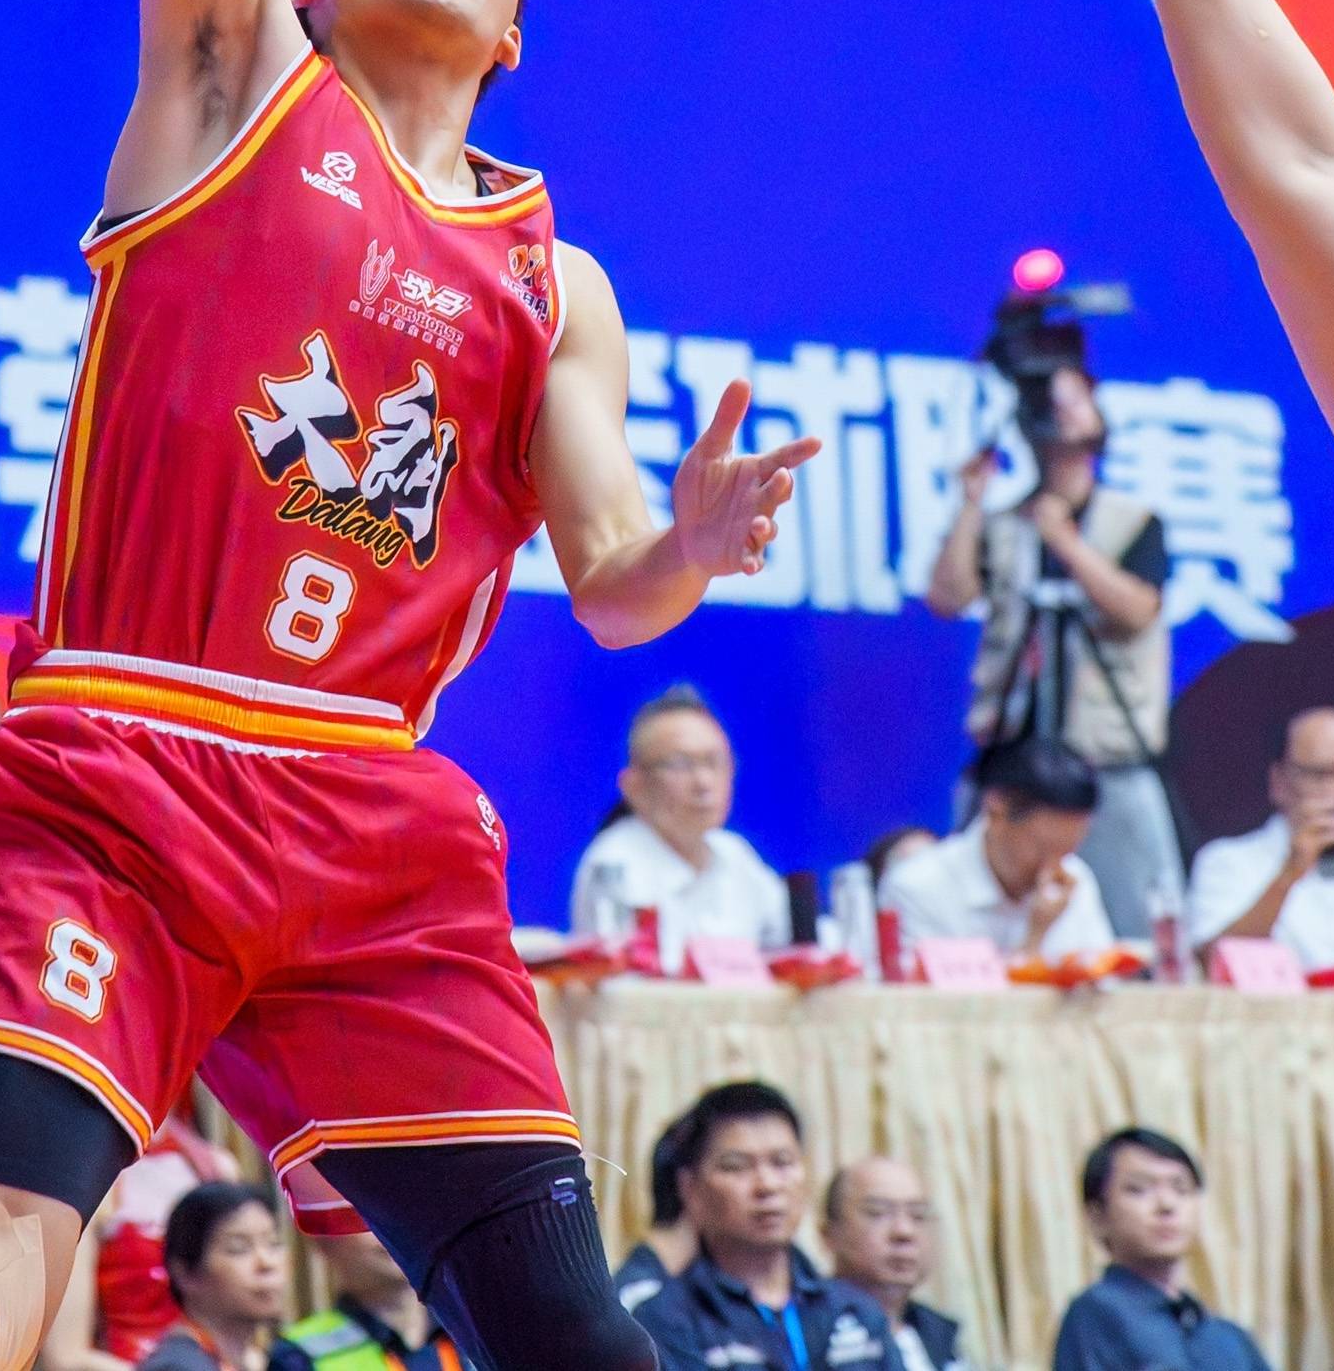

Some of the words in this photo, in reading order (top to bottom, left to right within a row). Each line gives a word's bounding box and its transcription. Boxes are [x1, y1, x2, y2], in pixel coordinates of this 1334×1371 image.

[278, 477, 413, 568] Dalang
[264, 550, 357, 664] 8
[38, 916, 117, 1023] 8
